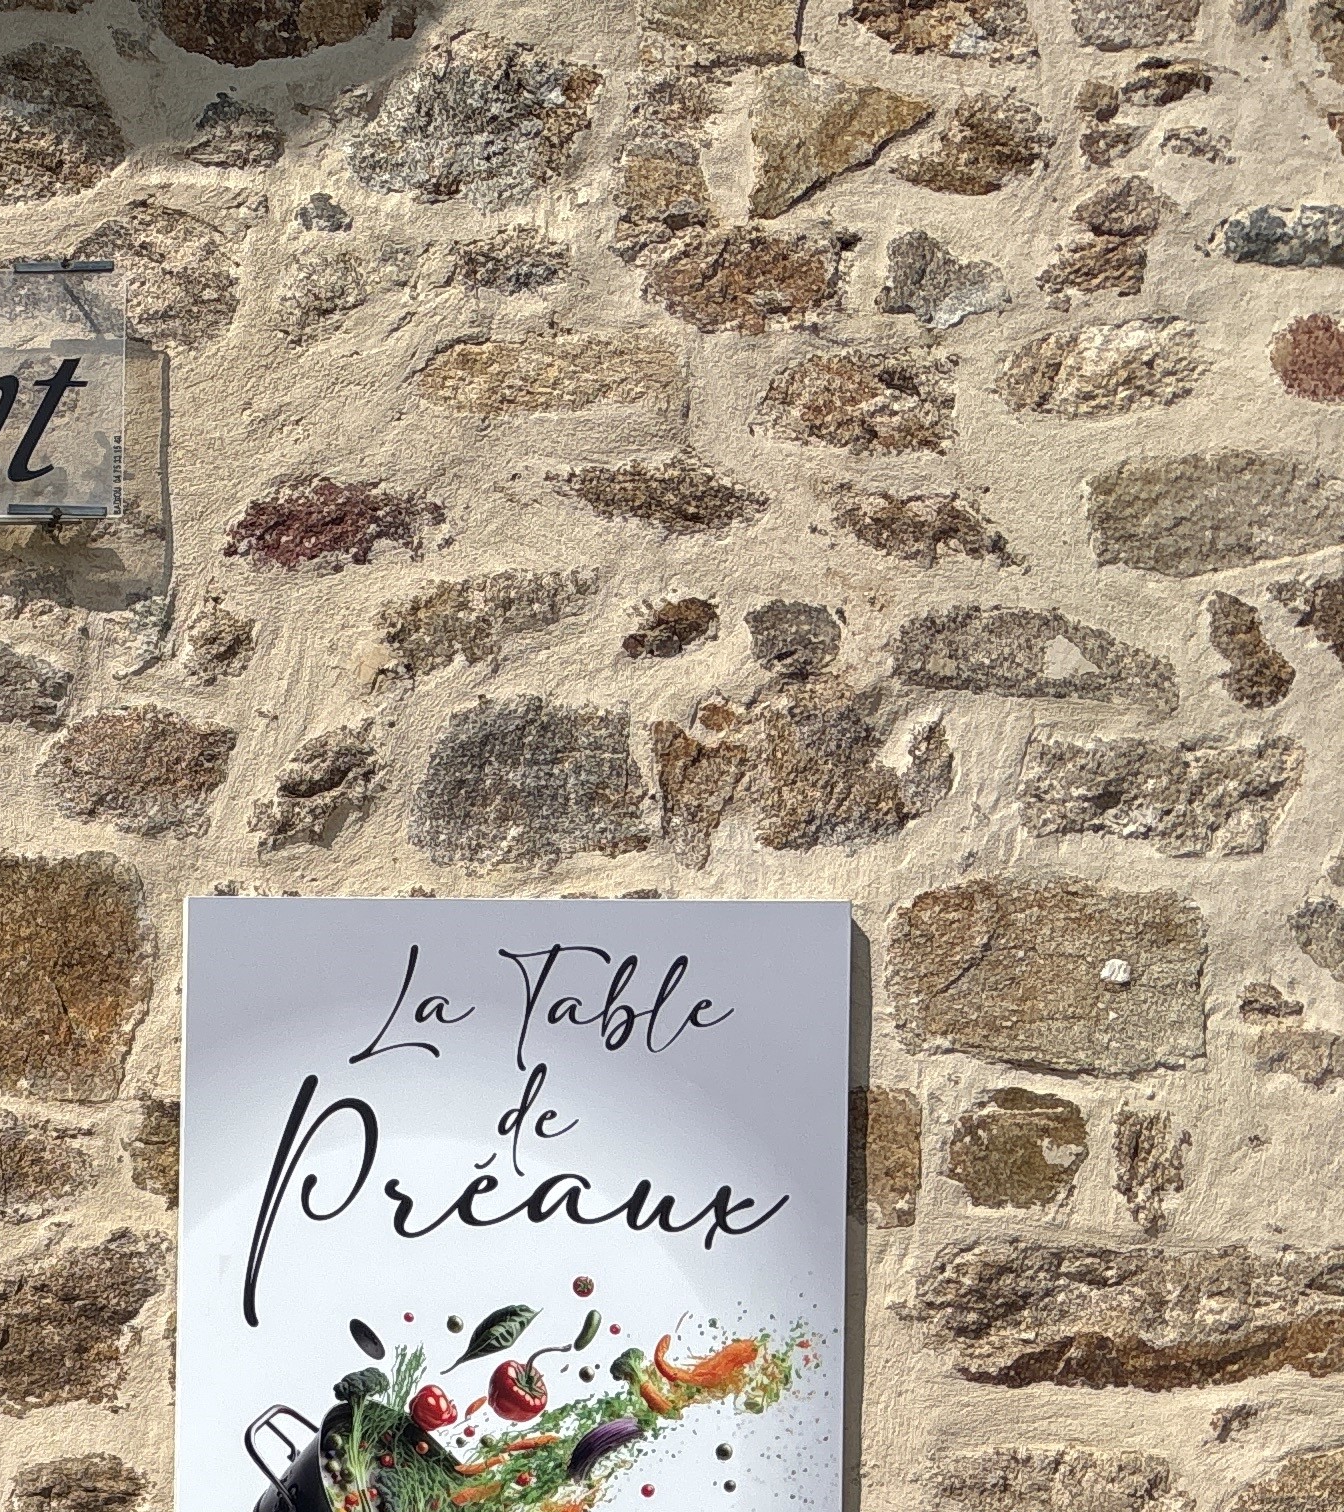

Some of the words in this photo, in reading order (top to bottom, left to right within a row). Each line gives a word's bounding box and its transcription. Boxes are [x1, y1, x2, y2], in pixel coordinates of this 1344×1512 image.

[349, 944, 475, 1065] La
[498, 943, 734, 1071] Table
[497, 1063, 580, 1176] de
[243, 1073, 789, 1328] Préaux
